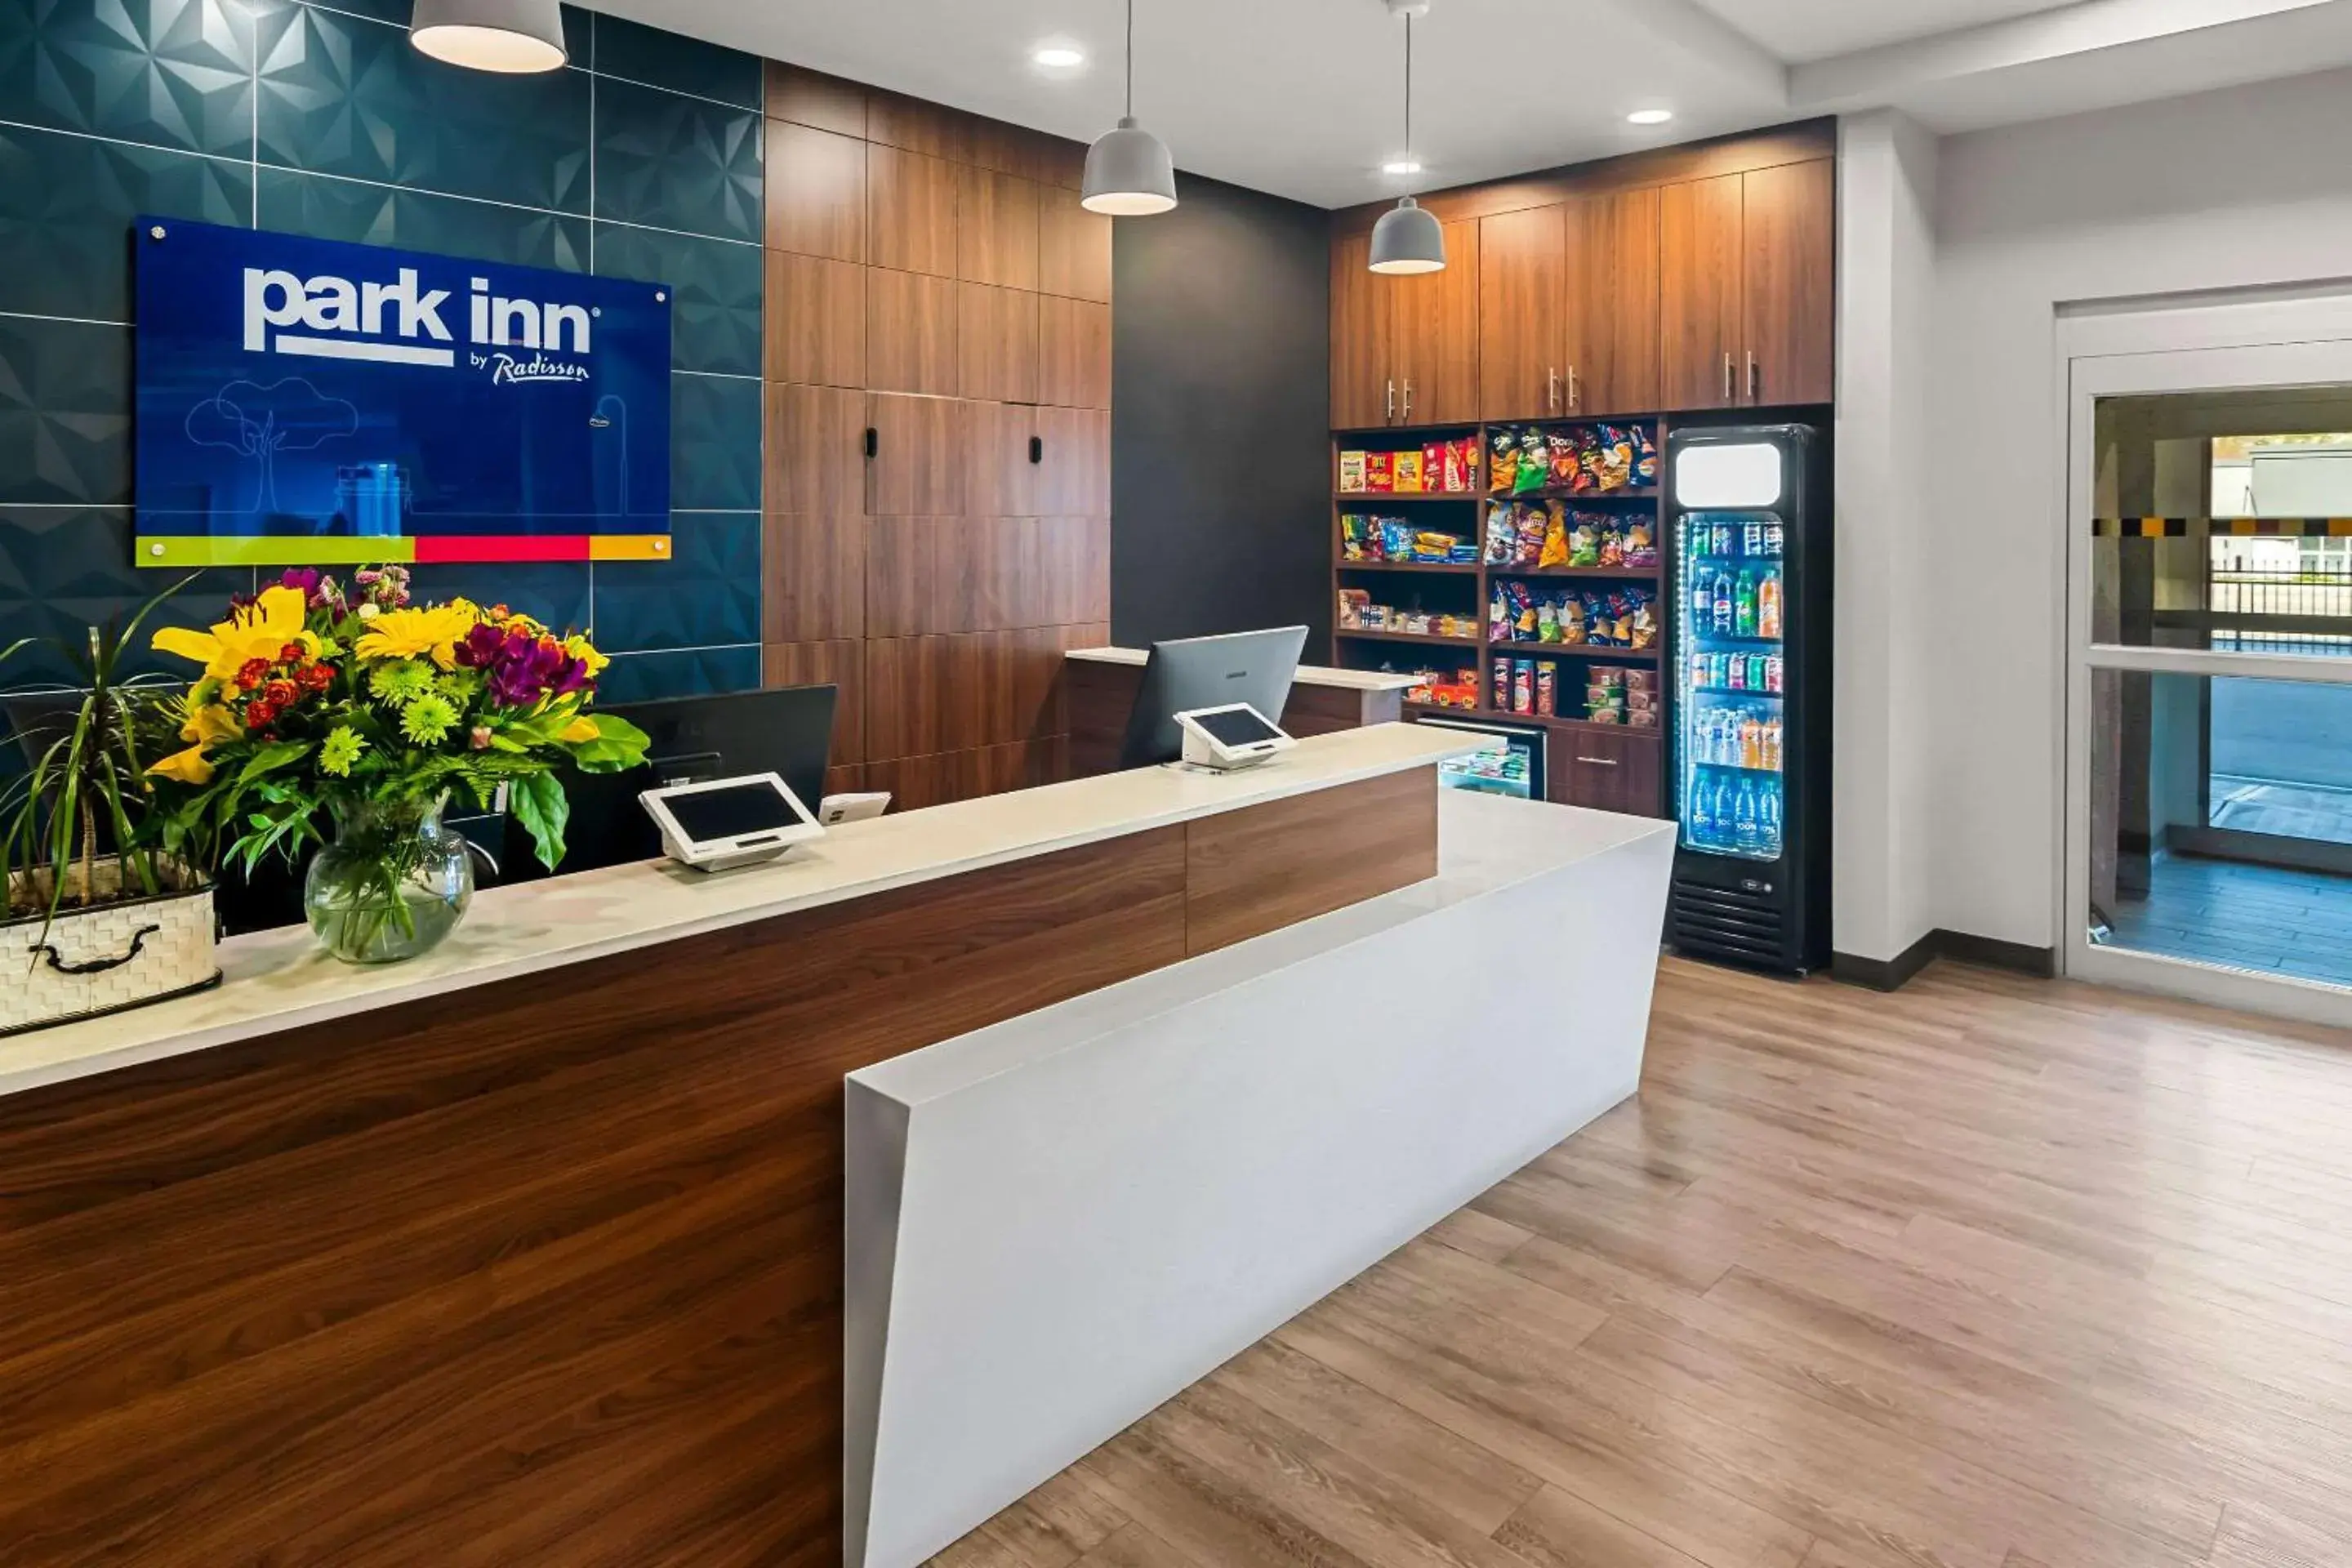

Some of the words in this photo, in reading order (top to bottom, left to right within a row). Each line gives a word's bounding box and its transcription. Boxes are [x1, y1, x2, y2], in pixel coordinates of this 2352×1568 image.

[243, 267, 453, 351] park
[470, 351, 488, 370] by
[492, 352, 590, 385] Radisson
